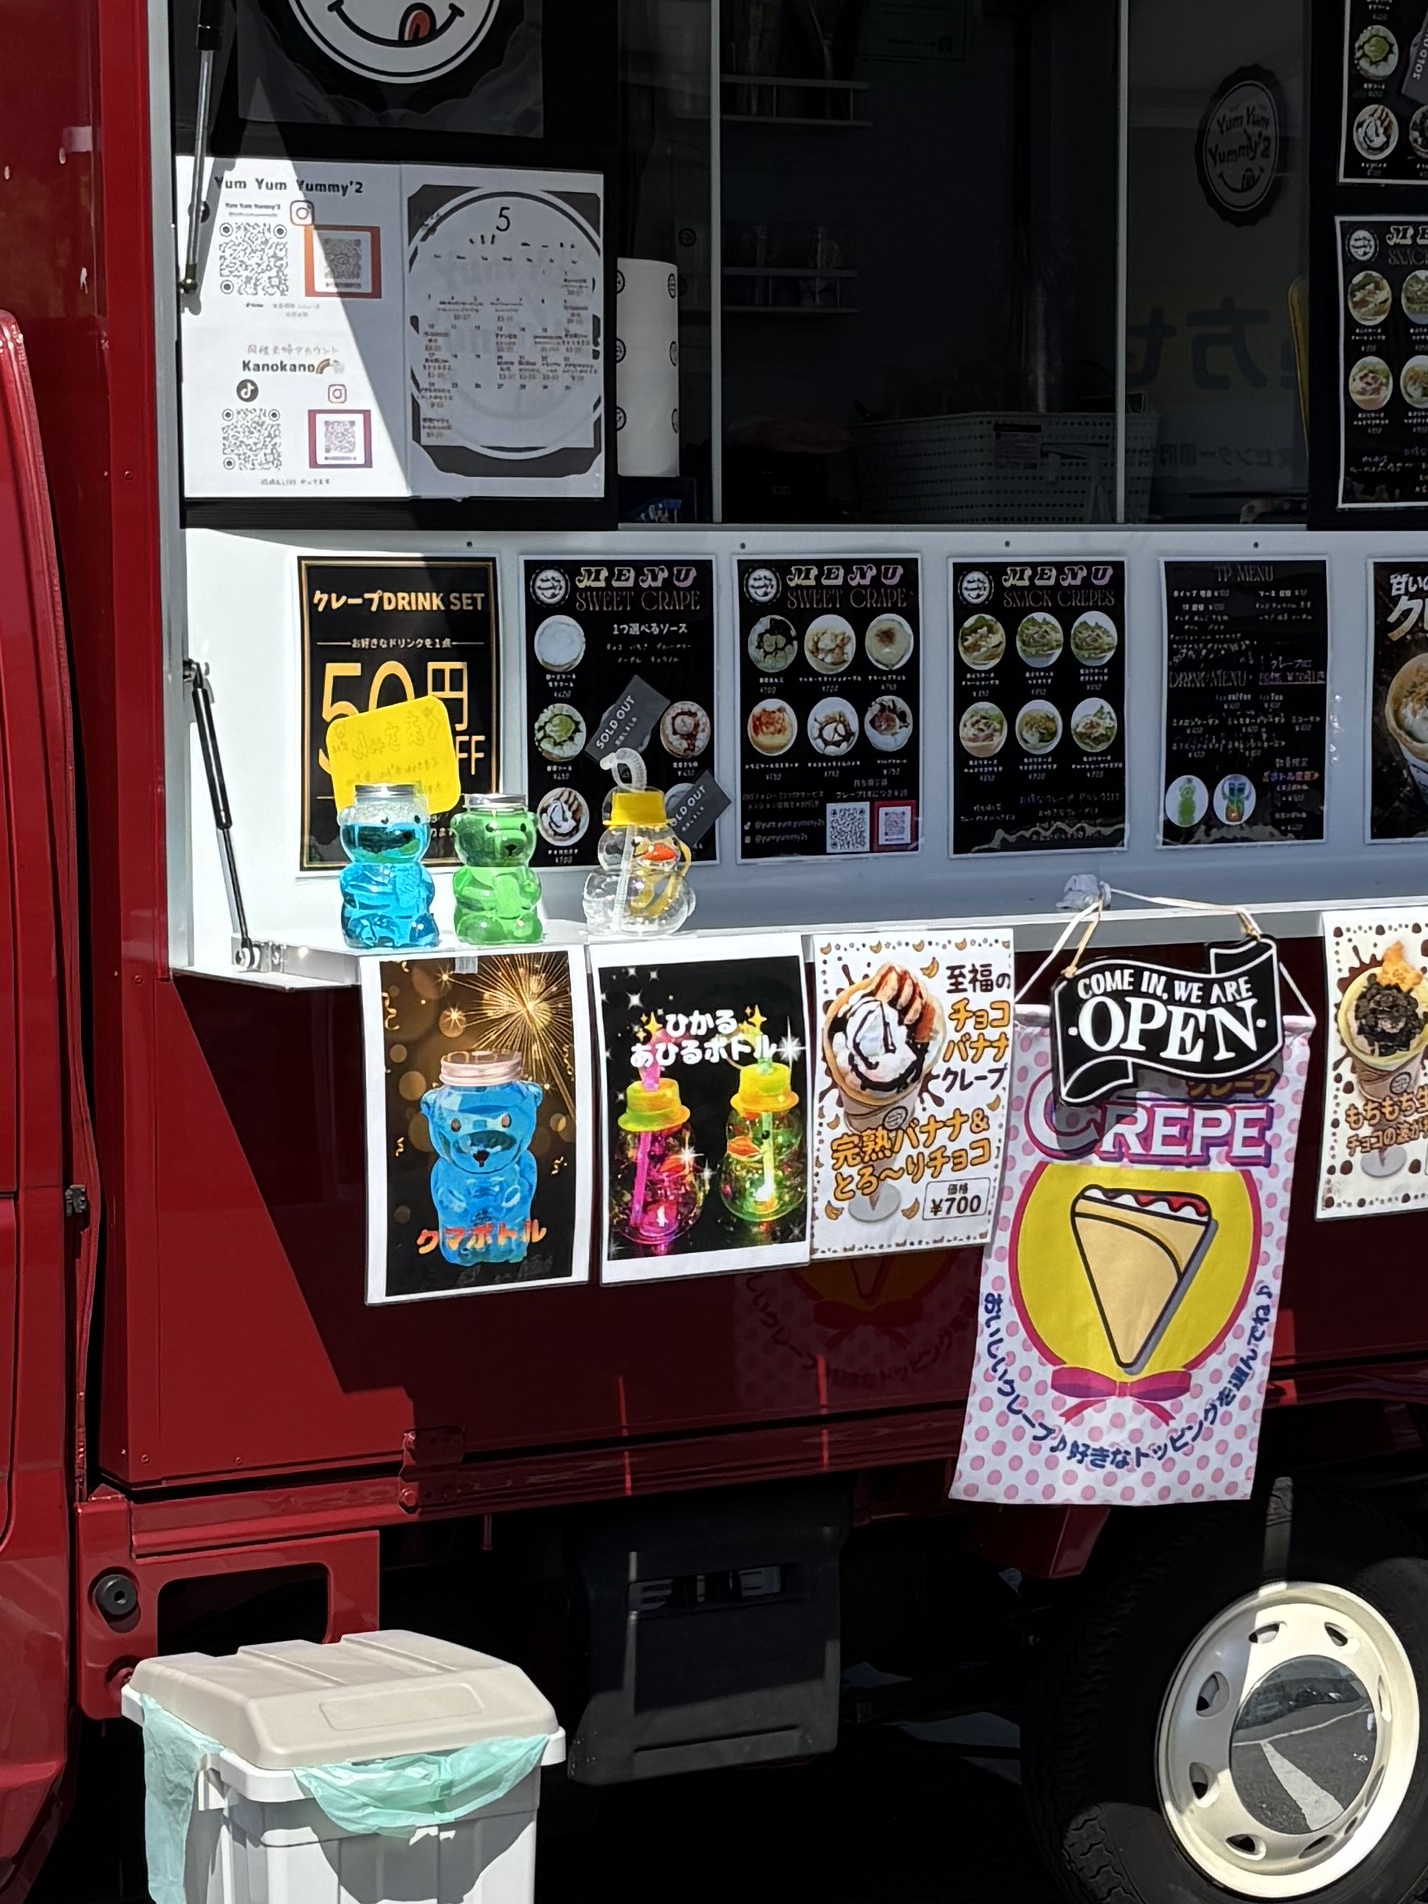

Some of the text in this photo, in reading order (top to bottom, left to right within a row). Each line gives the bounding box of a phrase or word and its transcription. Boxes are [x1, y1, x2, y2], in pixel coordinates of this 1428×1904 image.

[1412, 46, 1428, 81] SOLD
[1217, 106, 1269, 135] Yum Yum
[215, 176, 247, 190] Yum
[255, 177, 287, 191] Yum
[495, 206, 511, 232] 5
[242, 360, 316, 373] Kanokano
[576, 566, 698, 589] MENU
[786, 564, 904, 587] MENU
[1002, 565, 1113, 588] MENU
[1236, 564, 1274, 583] MENU
[312, 589, 485, 612] クレープDRINK SET
[576, 591, 700, 612] SWEET CRAPE
[787, 588, 907, 609] SWEET CRAPE
[1003, 588, 1115, 608] SNACK CREPES
[595, 694, 636, 750] SOLD OUT
[686, 784, 708, 808] OUT
[946, 963, 1011, 993] 至福の
[1077, 969, 1135, 999] COME
[1173, 980, 1204, 1003] WE
[1210, 976, 1253, 1004] ARE
[665, 1009, 738, 1038] ひかる
[948, 997, 1011, 1032] チョコ
[1078, 996, 1258, 1063] OPEN
[630, 1033, 778, 1068] あひるボトル
[942, 1032, 1009, 1063] バナナ
[941, 1063, 1009, 1093] クレープ
[1024, 1074, 1272, 1167] CREPE
[830, 1107, 990, 1171] 完熟バナナ&
[929, 1195, 982, 1216] ¥700
[416, 1217, 546, 1255] クマボトル
